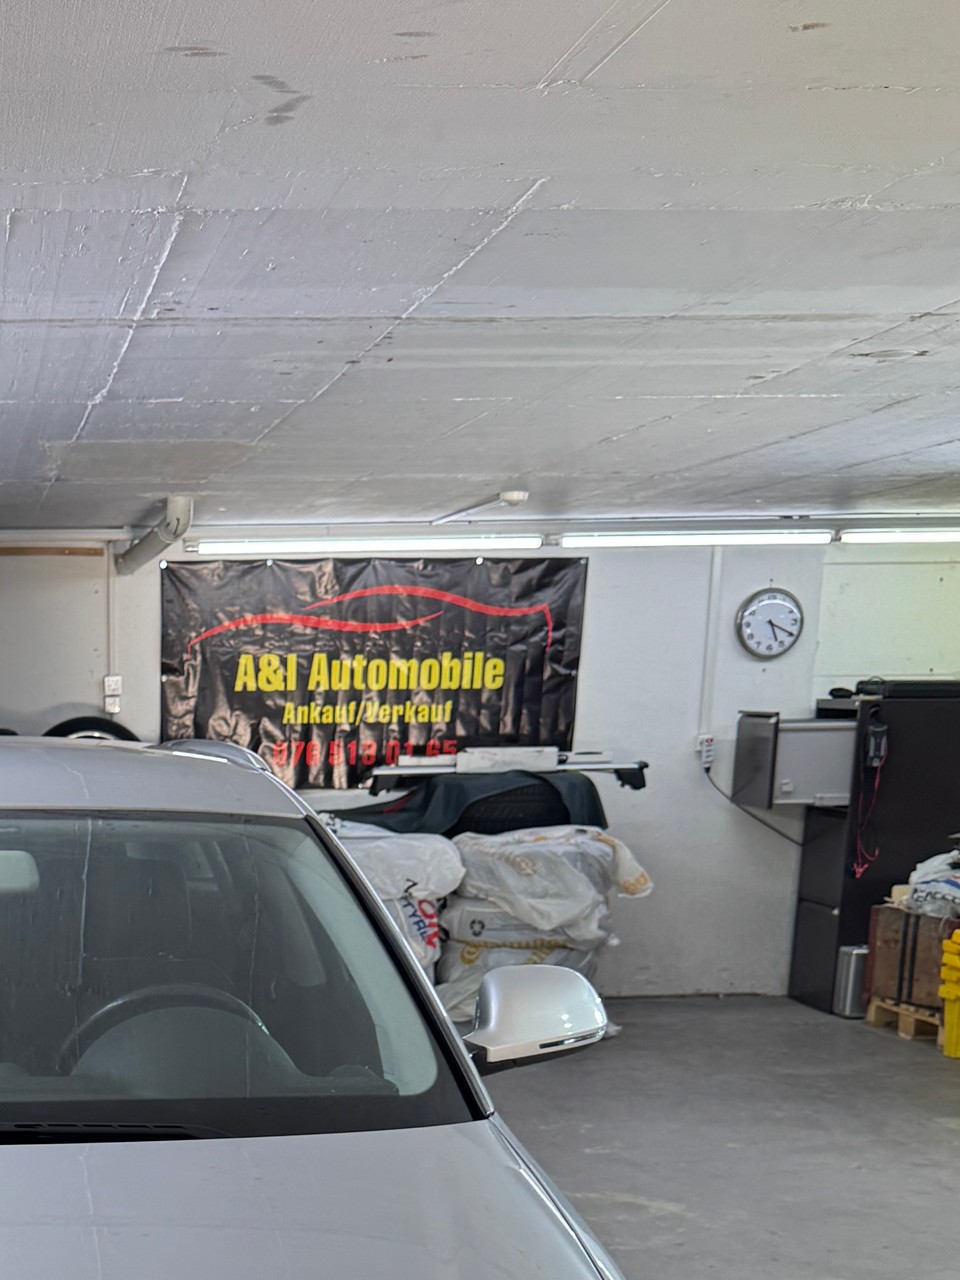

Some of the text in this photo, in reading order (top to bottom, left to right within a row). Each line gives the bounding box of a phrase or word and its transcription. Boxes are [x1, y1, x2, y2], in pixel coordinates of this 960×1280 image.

[234, 651, 506, 692] A&I Automobile
[282, 700, 453, 726] Ankauf/Verkauf
[272, 740, 321, 767] 076
[328, 739, 378, 767] 513
